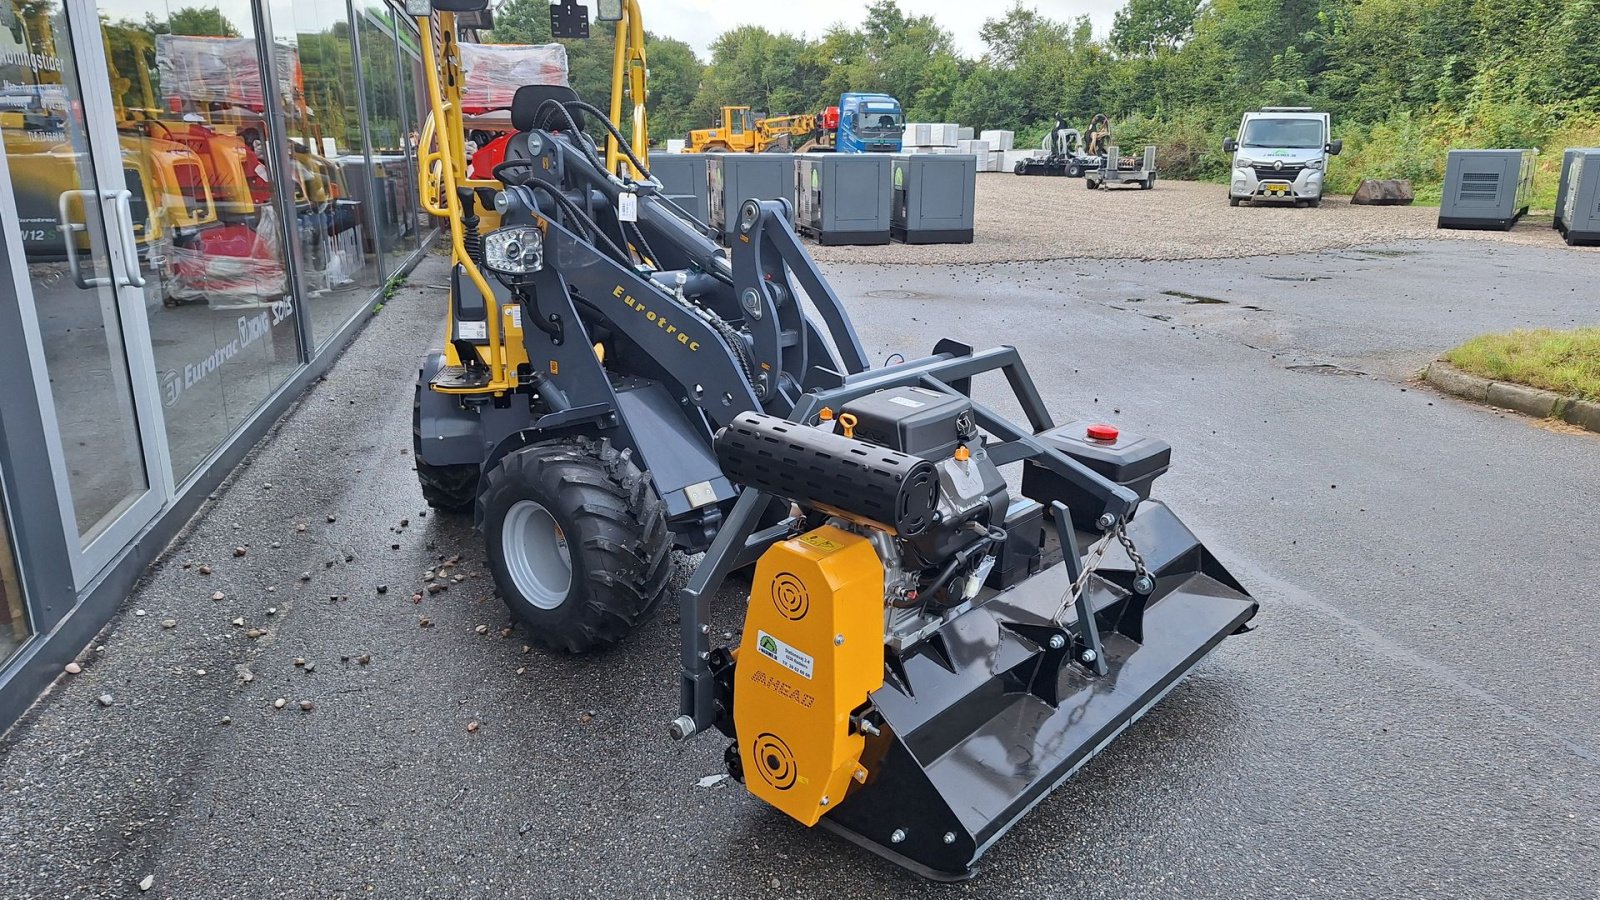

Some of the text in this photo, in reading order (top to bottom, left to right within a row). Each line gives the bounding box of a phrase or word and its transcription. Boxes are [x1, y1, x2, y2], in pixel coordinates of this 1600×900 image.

[612, 284, 701, 352] Eurotrac
[184, 339, 239, 390] Eurotrac
[751, 670, 815, 708] AHEAD
